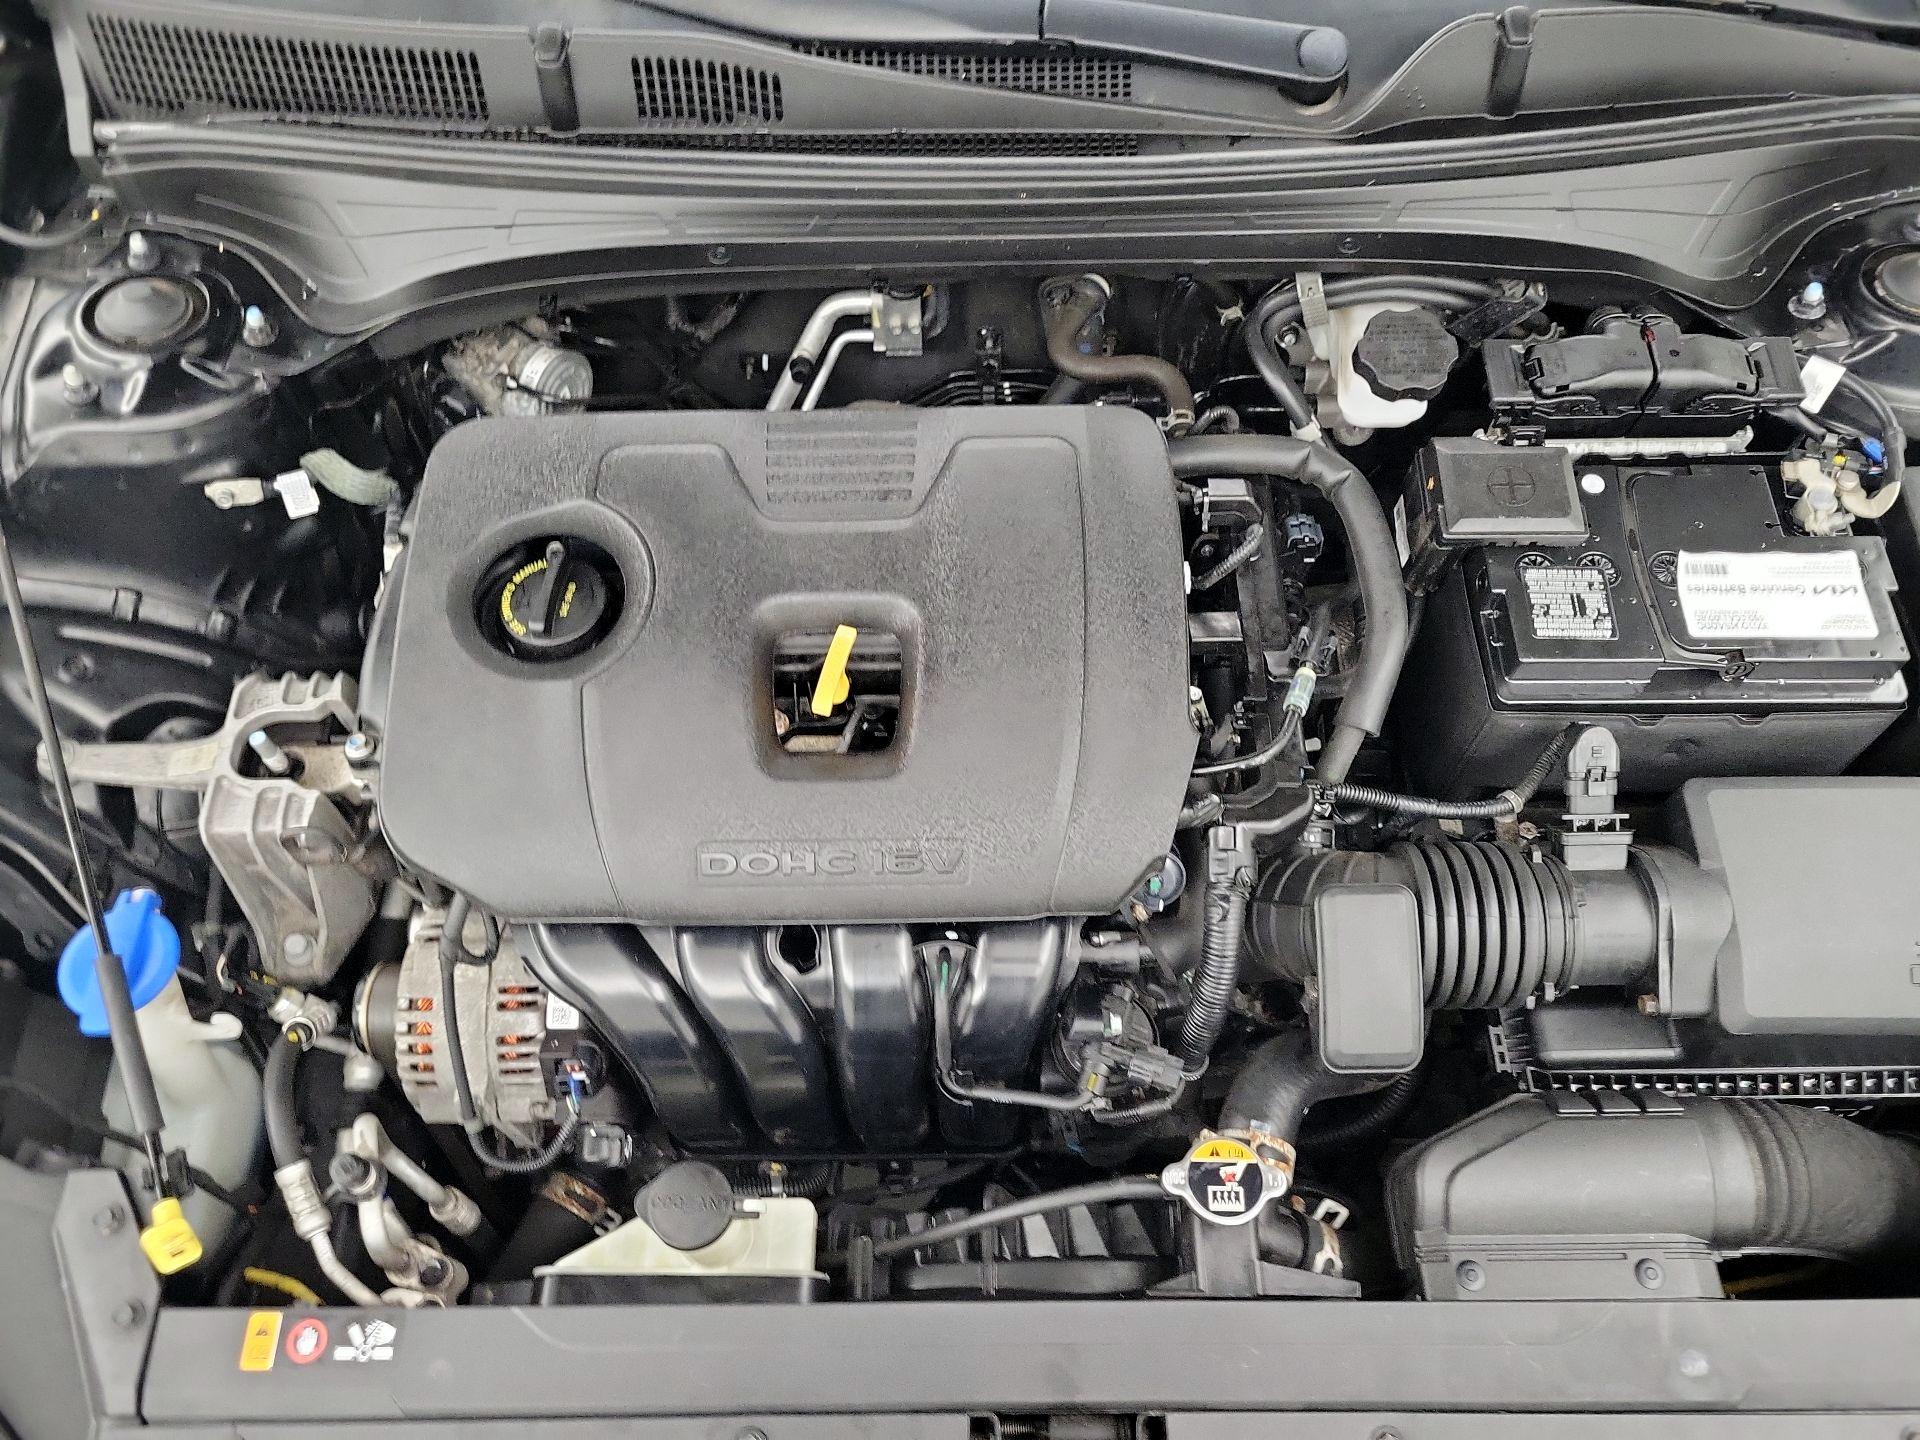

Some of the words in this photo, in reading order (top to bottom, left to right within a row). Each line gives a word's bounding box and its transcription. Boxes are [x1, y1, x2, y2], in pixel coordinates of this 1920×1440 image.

[1687, 583, 1746, 596] Batteries
[1749, 583, 1806, 596] Genuine
[700, 850, 857, 876] DOHC
[871, 849, 965, 875] 16V
